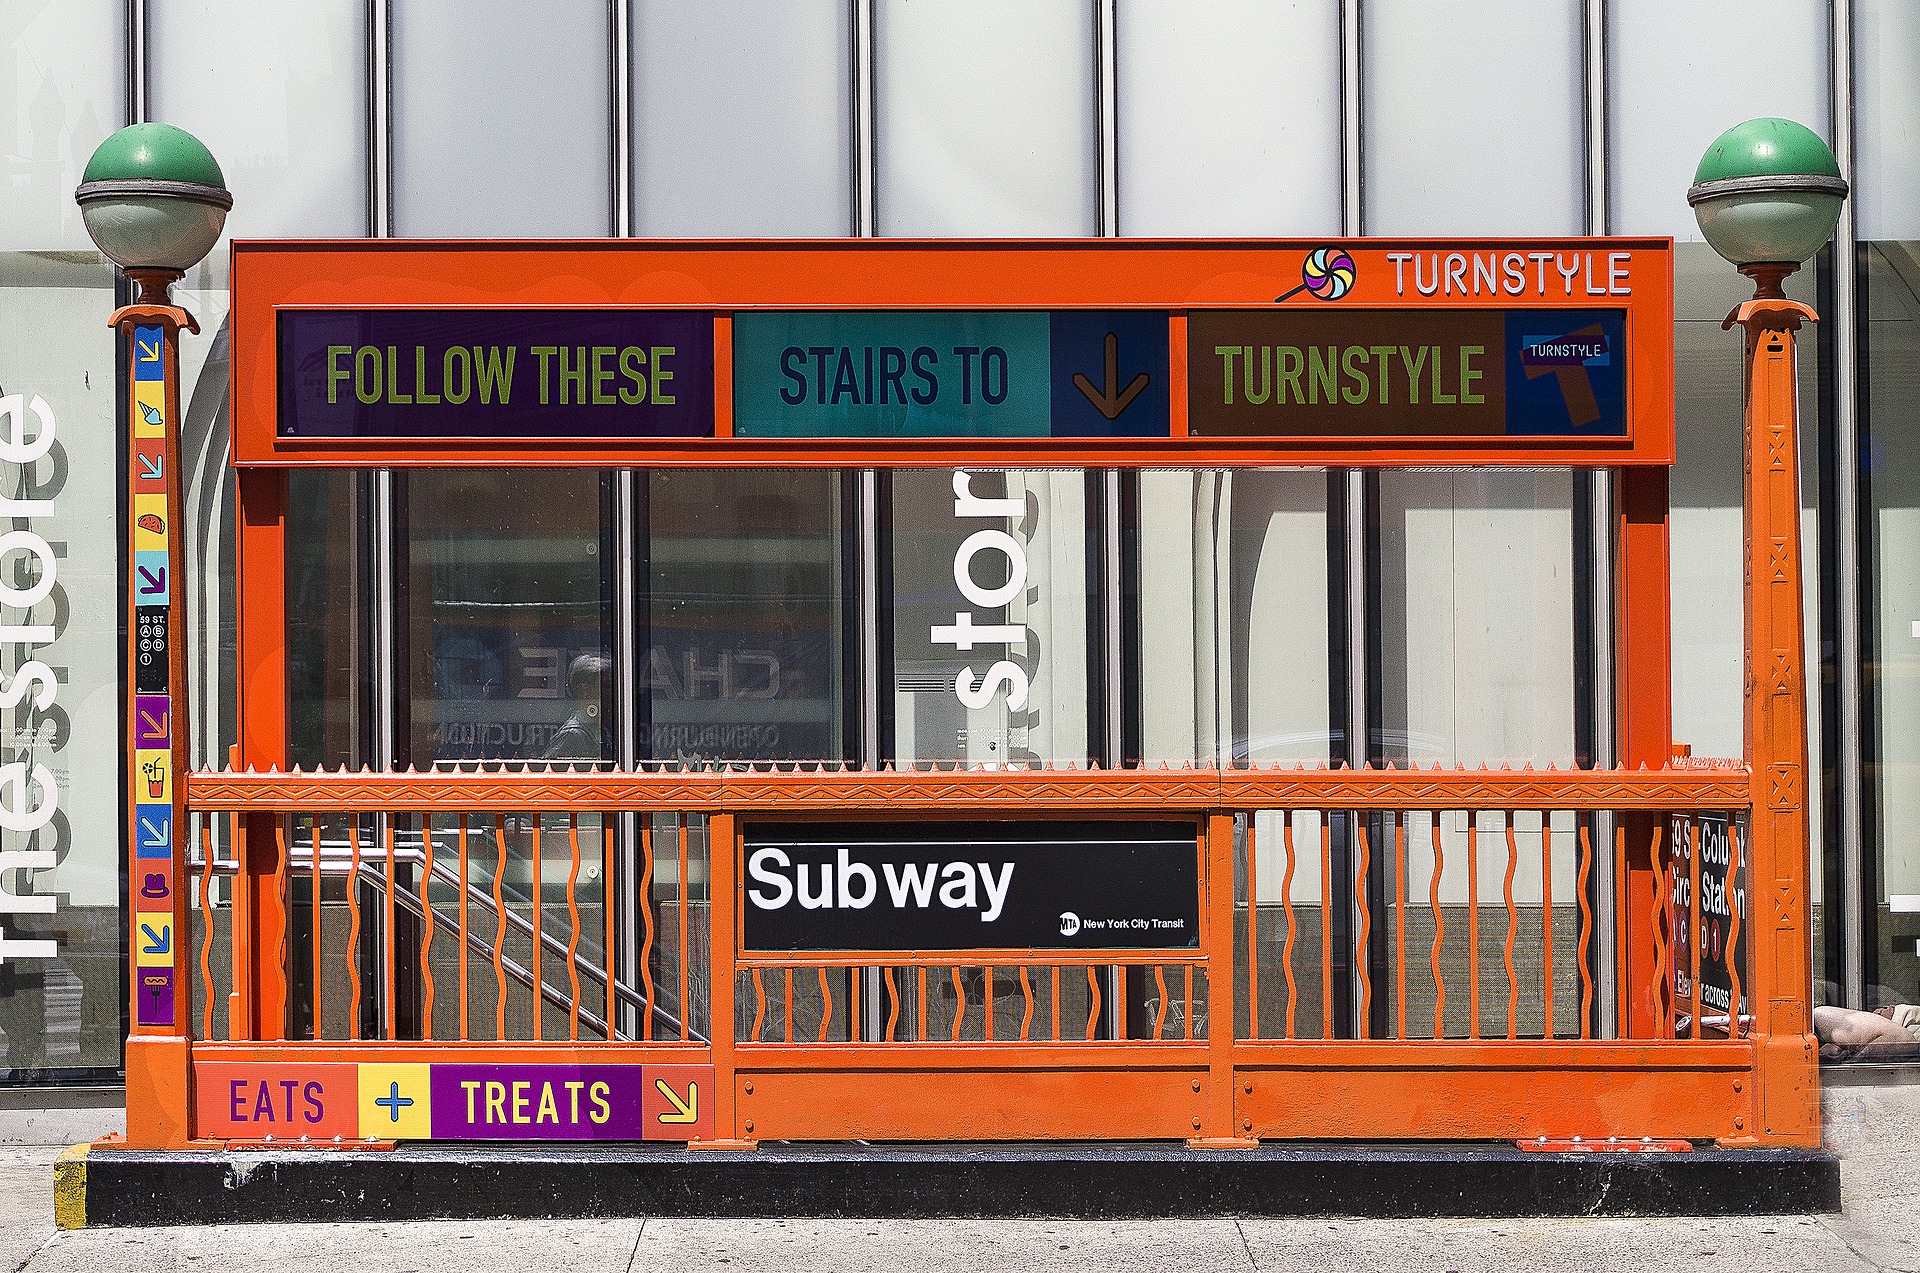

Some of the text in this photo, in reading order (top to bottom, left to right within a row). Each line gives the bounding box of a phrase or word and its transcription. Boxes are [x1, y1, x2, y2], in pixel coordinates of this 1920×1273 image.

[1387, 252, 1632, 295] TURNSTYLE
[327, 345, 676, 405] FOLLOW THESE
[779, 346, 1009, 405] STAIRS TO
[1215, 345, 1485, 404] TURNSTYLE
[1530, 344, 1601, 357] TURNSTYLE
[930, 470, 1028, 712] stor
[747, 847, 1016, 922] Subway
[1083, 919, 1105, 929] New
[1107, 919, 1129, 928] York
[1130, 919, 1149, 930] City
[1151, 918, 1185, 929] Transit
[230, 1080, 325, 1124] EATS
[461, 1081, 611, 1124] TREATS
